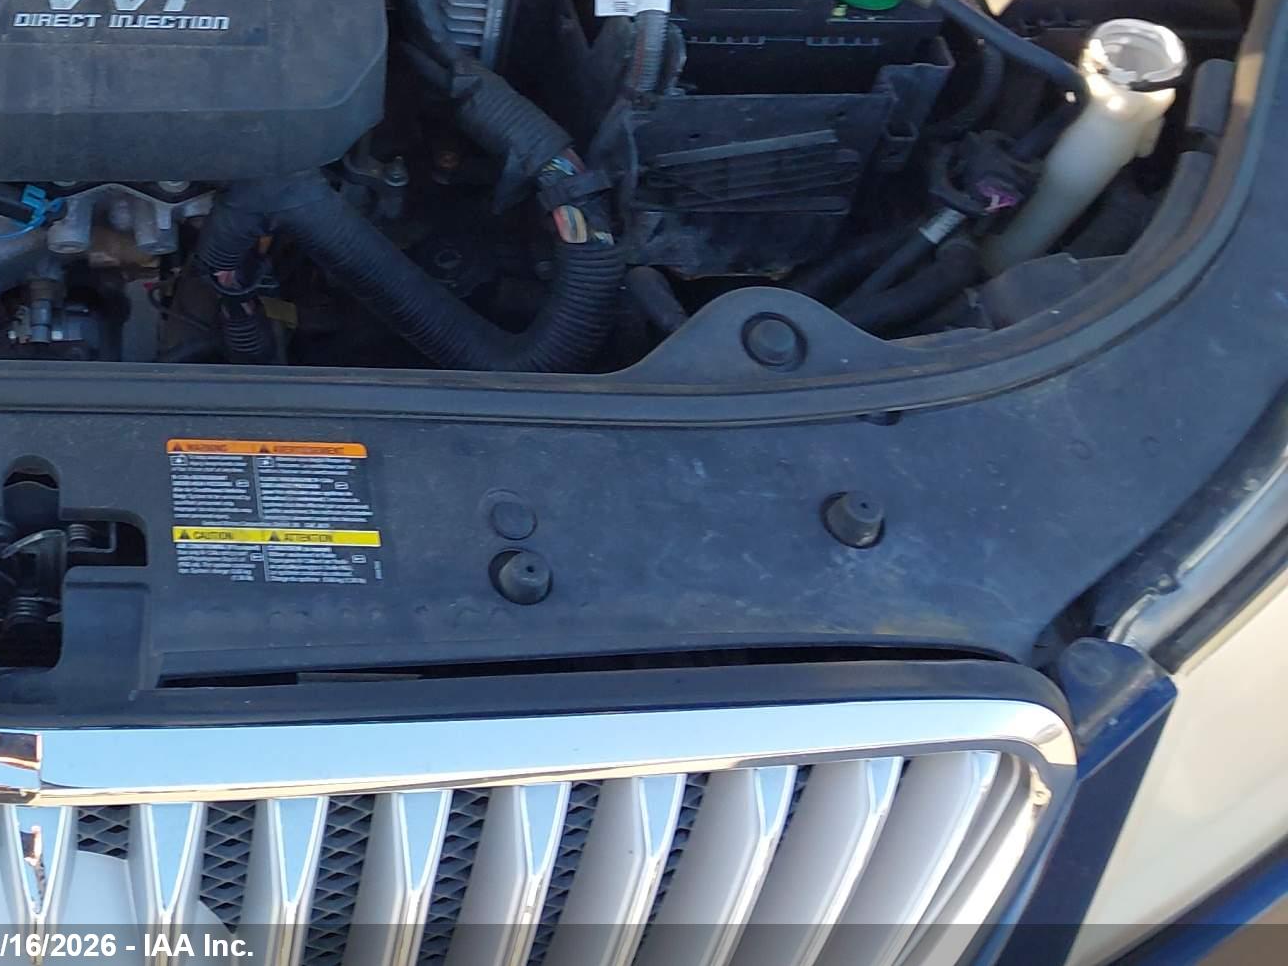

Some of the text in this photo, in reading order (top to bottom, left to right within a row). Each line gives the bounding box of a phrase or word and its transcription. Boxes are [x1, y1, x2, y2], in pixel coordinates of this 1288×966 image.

[13, 13, 230, 30] DIRECT INJECTION
[192, 530, 233, 540] CAUTION
